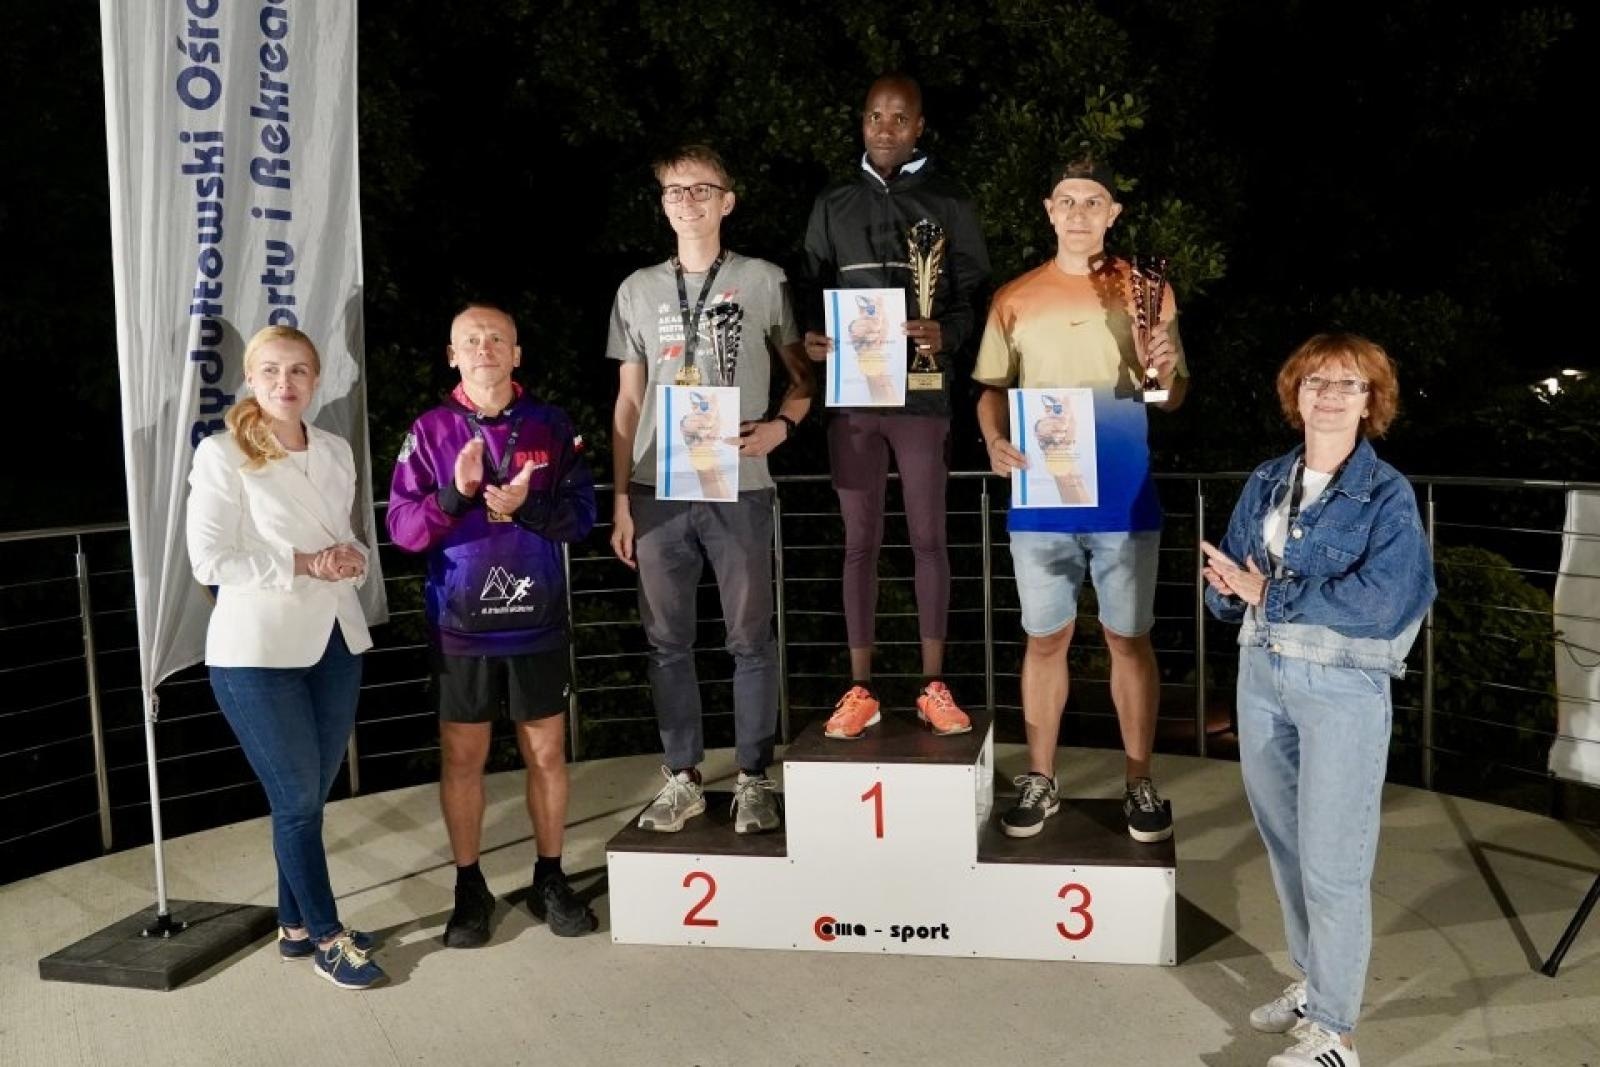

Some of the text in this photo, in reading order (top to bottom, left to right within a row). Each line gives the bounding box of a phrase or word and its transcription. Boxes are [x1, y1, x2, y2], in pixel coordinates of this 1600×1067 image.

[250, 0, 299, 327] ortu i Rekrea
[180, 132, 235, 449] Rydułtowski
[861, 781, 884, 838] 1
[682, 871, 718, 928] 2
[1057, 883, 1094, 942] 3
[890, 923, 950, 942] sport
